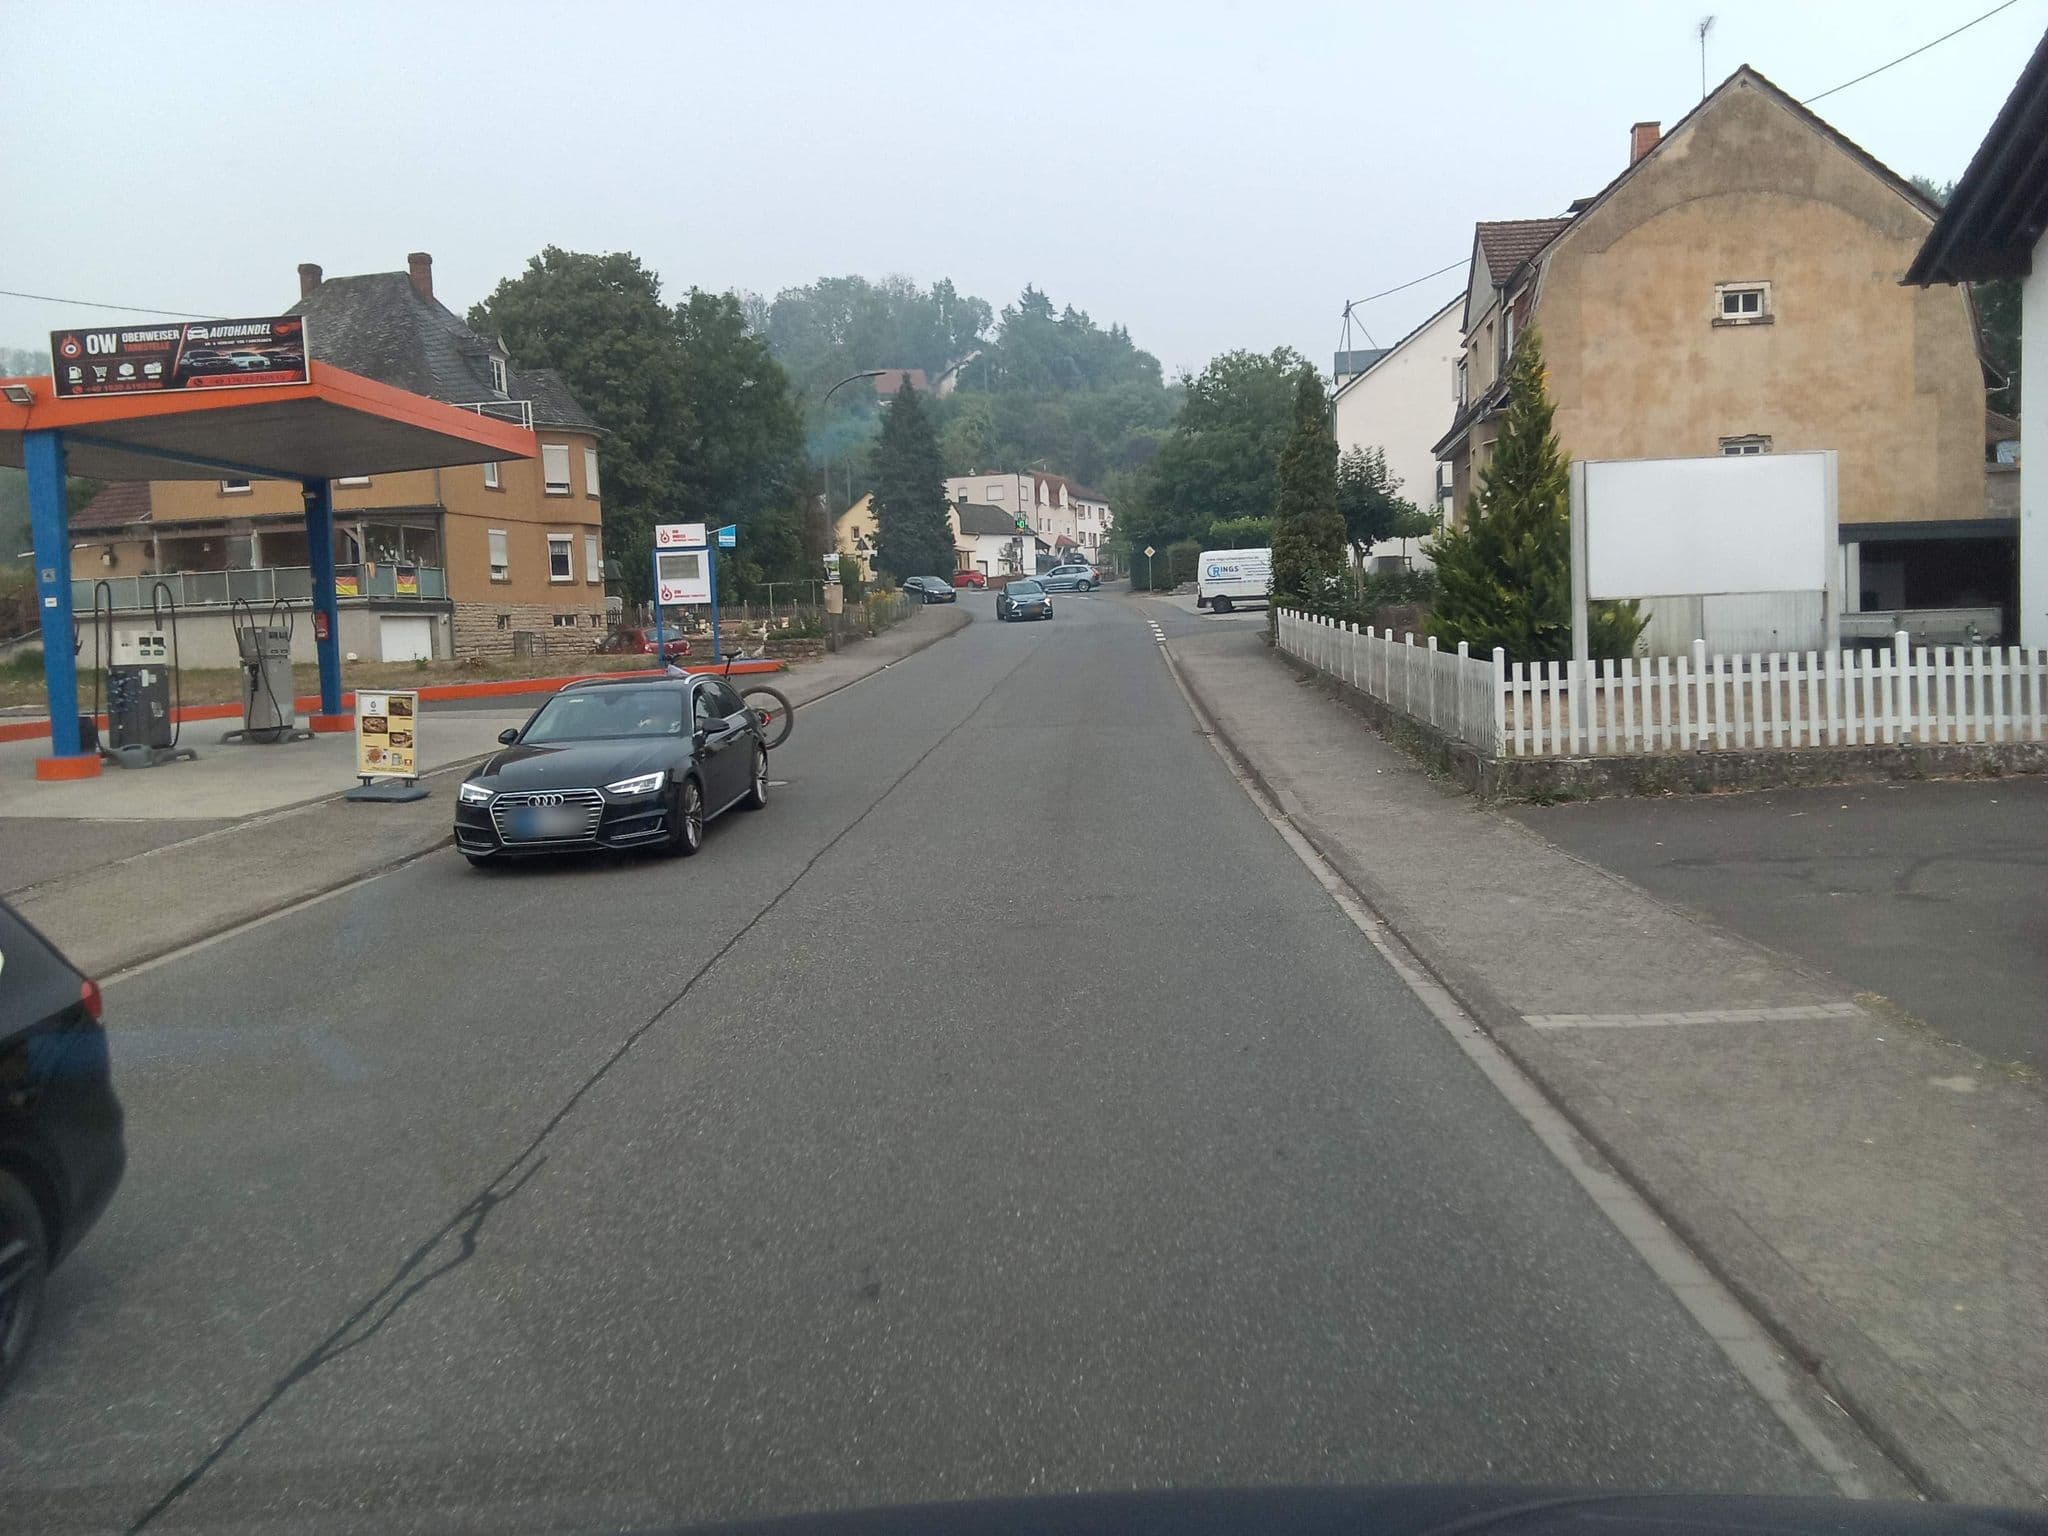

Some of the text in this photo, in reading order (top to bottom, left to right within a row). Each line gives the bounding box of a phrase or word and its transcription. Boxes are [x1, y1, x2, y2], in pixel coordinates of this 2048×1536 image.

[121, 329, 181, 343] OBERWEISER
[209, 323, 272, 338] AUTOHANDEL
[86, 333, 117, 355] OW
